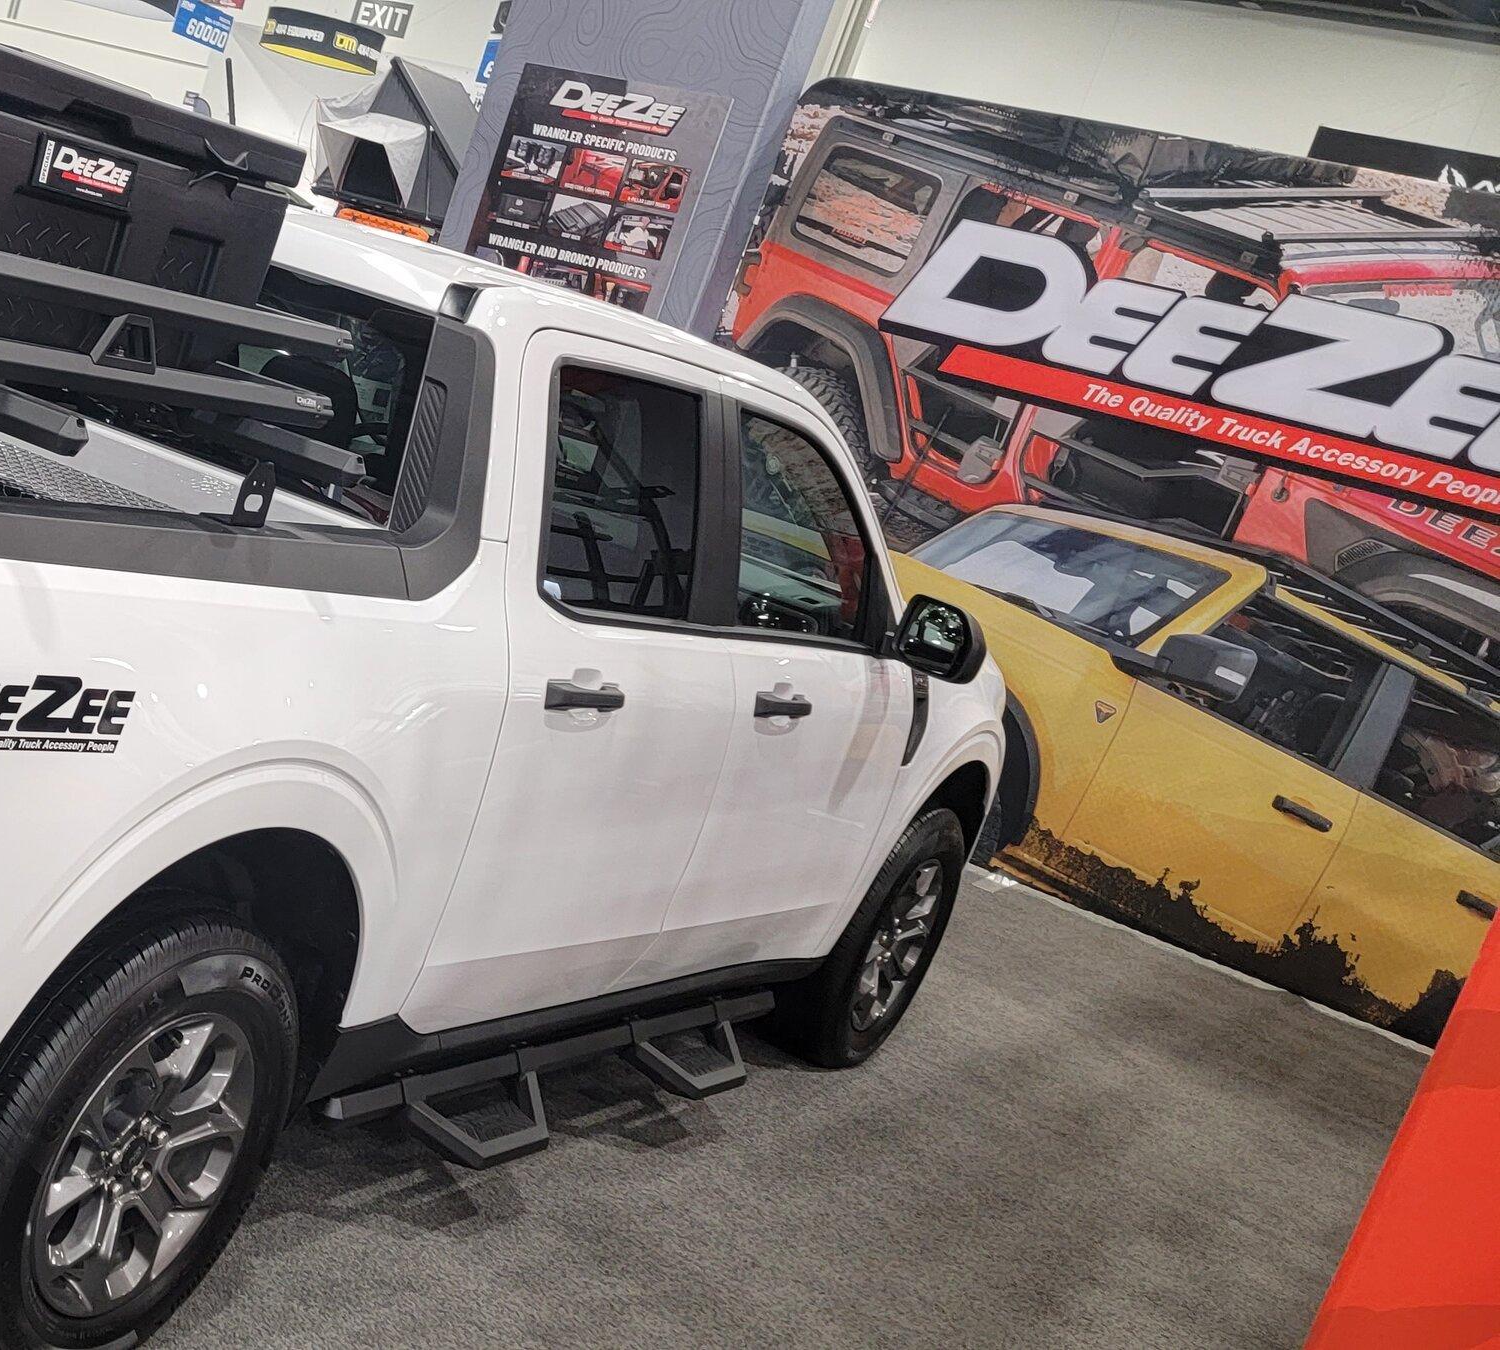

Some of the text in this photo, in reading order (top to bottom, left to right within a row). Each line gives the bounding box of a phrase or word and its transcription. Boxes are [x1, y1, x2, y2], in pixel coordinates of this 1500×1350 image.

[186, 17, 228, 49] 60000
[356, 2, 409, 32] EXIT
[550, 79, 687, 128] DEEZEE
[40, 141, 55, 182] SPECIALTY
[532, 123, 678, 163] WRANGLER SPECIFIC PRODUCTS
[53, 146, 132, 188] DEEZEE
[488, 232, 648, 280] WRANGLER AND BRONCO PRODUCTS
[1082, 384, 1500, 505] The Quality Truck Accessory Peop
[1387, 498, 1500, 556] DEE
[18, 739, 41, 749] Truck
[42, 740, 86, 752] Accessory
[87, 742, 115, 755] People
